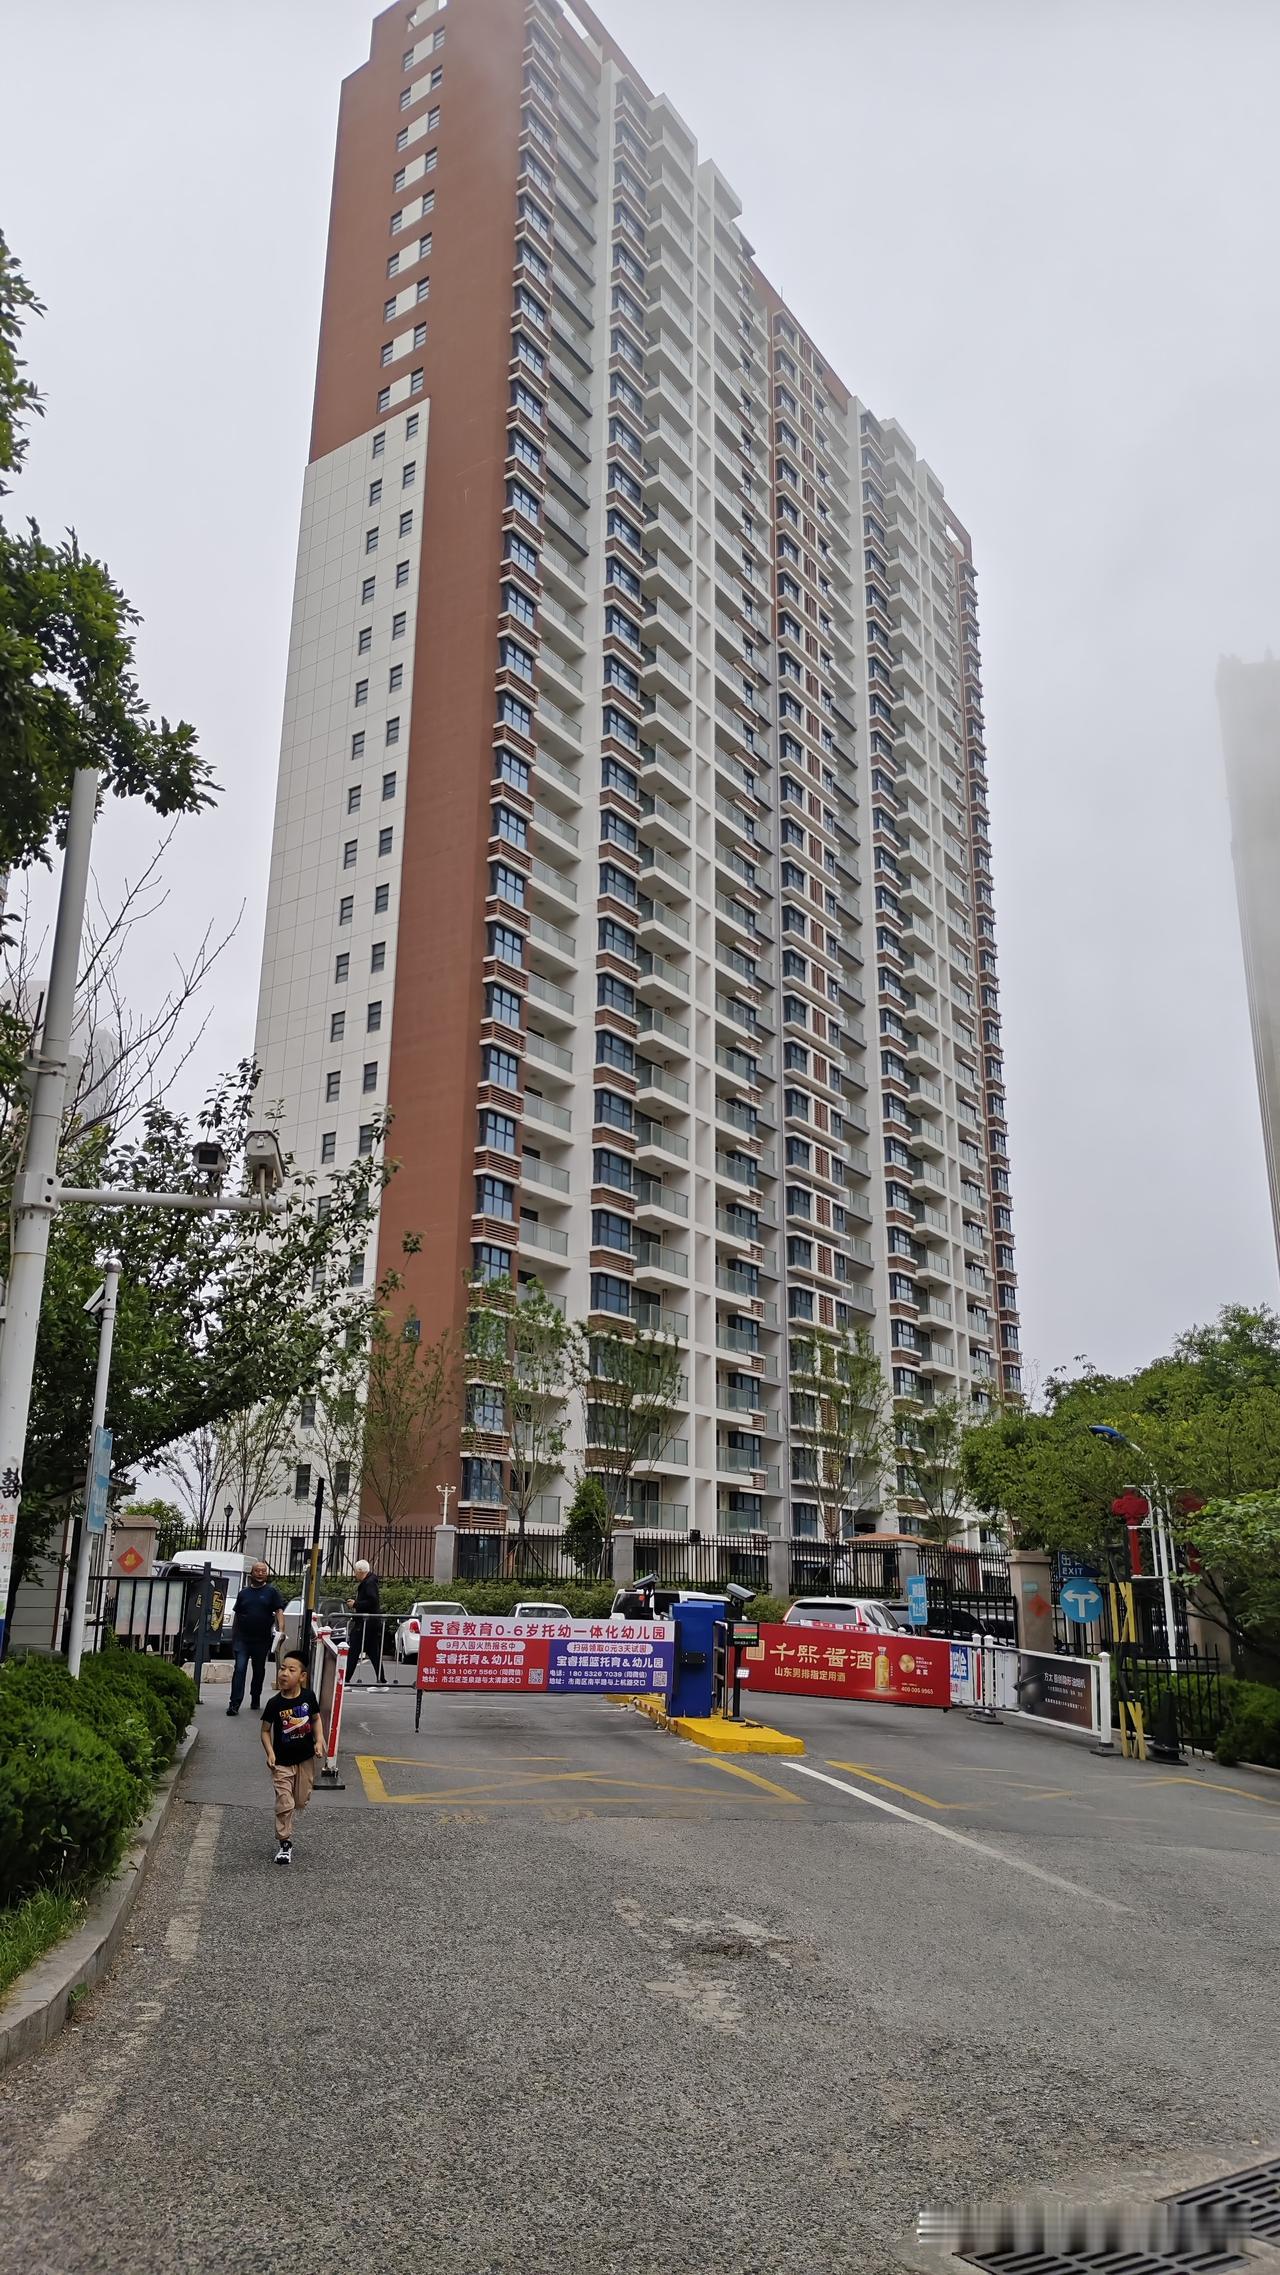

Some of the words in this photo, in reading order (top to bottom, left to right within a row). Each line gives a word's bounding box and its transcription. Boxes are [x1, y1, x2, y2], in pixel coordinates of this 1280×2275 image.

[1062, 1567, 1083, 1575] EXIT
[429, 1620, 665, 1640] 宝睿教育0-6岁托幼一体化幼儿园
[446, 1640, 516, 1650] 9月入园火热报名中
[769, 1642, 875, 1671] 千熙酱酒
[774, 1667, 846, 1682] 山东男排指定用酒
